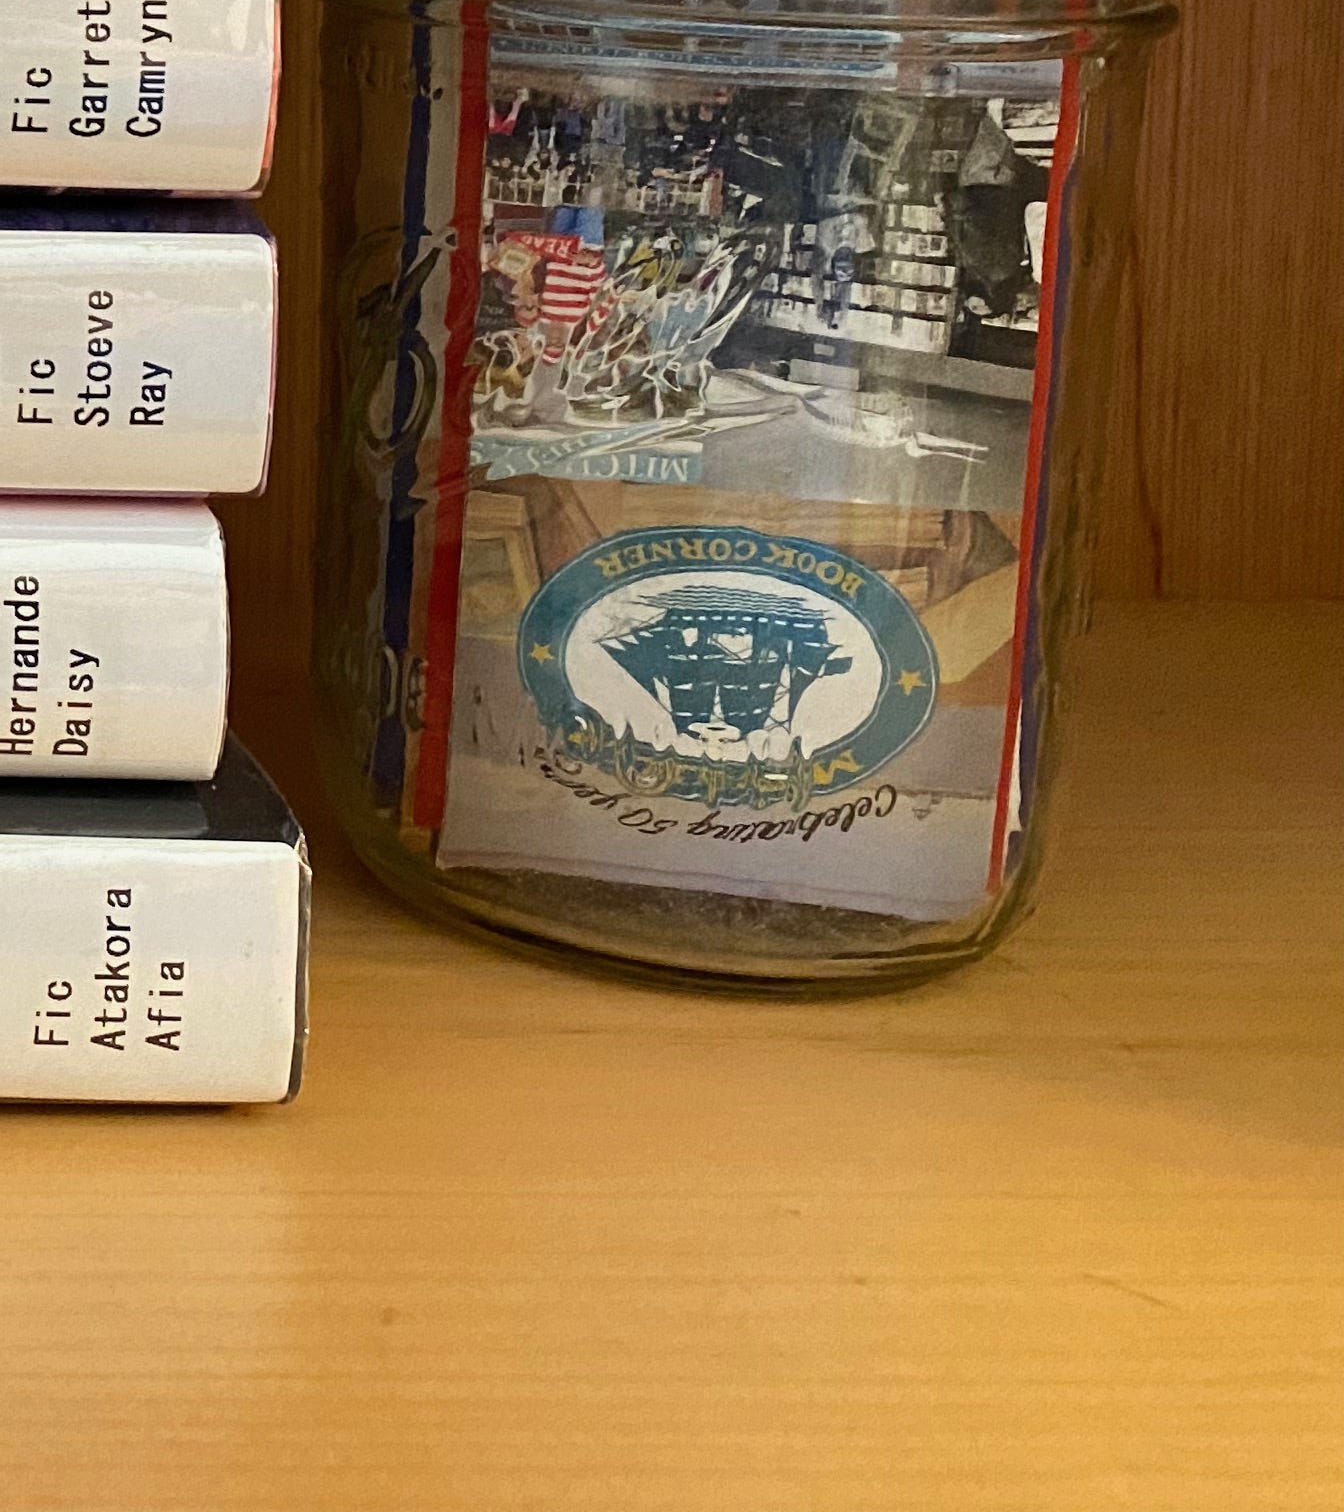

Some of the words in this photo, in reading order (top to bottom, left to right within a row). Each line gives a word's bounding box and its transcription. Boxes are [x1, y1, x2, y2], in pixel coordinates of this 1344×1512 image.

[11, 65, 54, 133] Fic
[125, 0, 173, 138] Camryn
[17, 356, 56, 425] Fic
[73, 289, 115, 428] Stoeve
[129, 360, 173, 427] Ray
[592, 536, 758, 578] CORNER
[763, 542, 866, 599] BOOK
[52, 648, 100, 757] Daisy
[617, 806, 679, 837] 50
[686, 783, 898, 844] Celebrating
[89, 886, 133, 1052] Atakora
[32, 979, 73, 1047] Fic
[144, 960, 186, 1052] Afia
